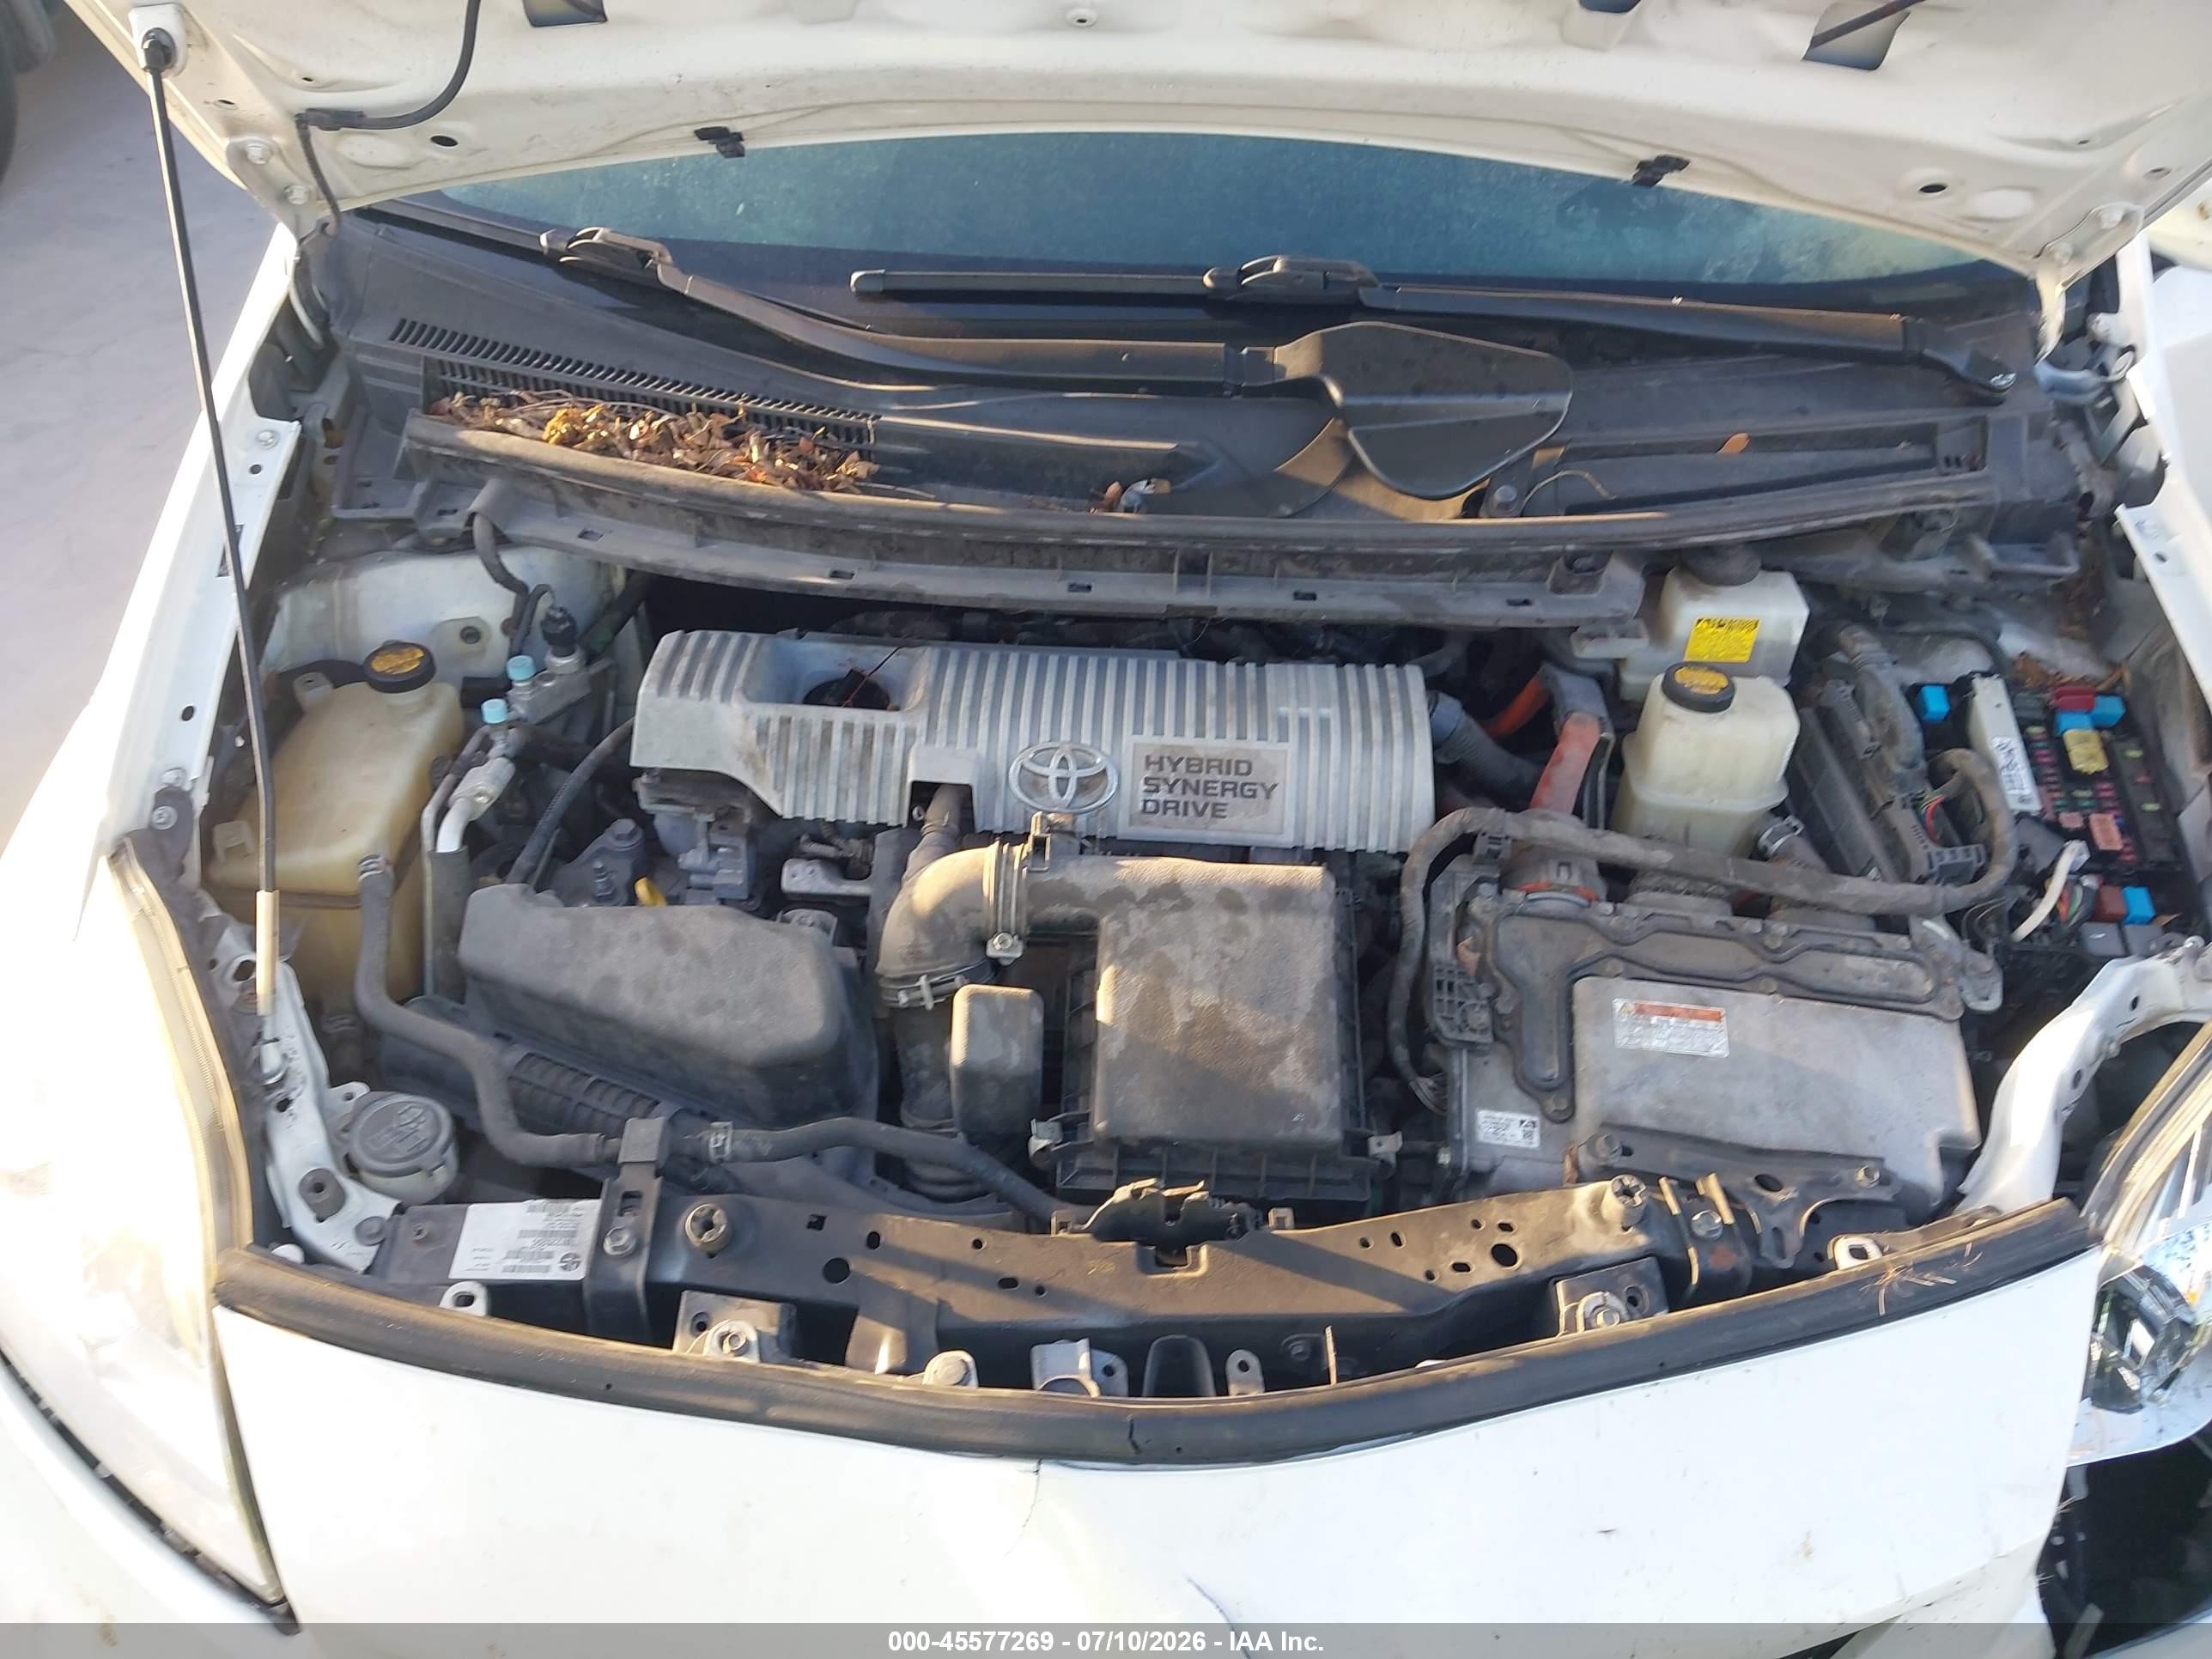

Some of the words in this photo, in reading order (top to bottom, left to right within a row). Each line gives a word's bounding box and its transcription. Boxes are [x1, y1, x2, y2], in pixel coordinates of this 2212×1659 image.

[1145, 755, 1253, 776] HYBRID
[1143, 776, 1279, 799] SYNERGY
[1141, 799, 1228, 818] DRIVE
